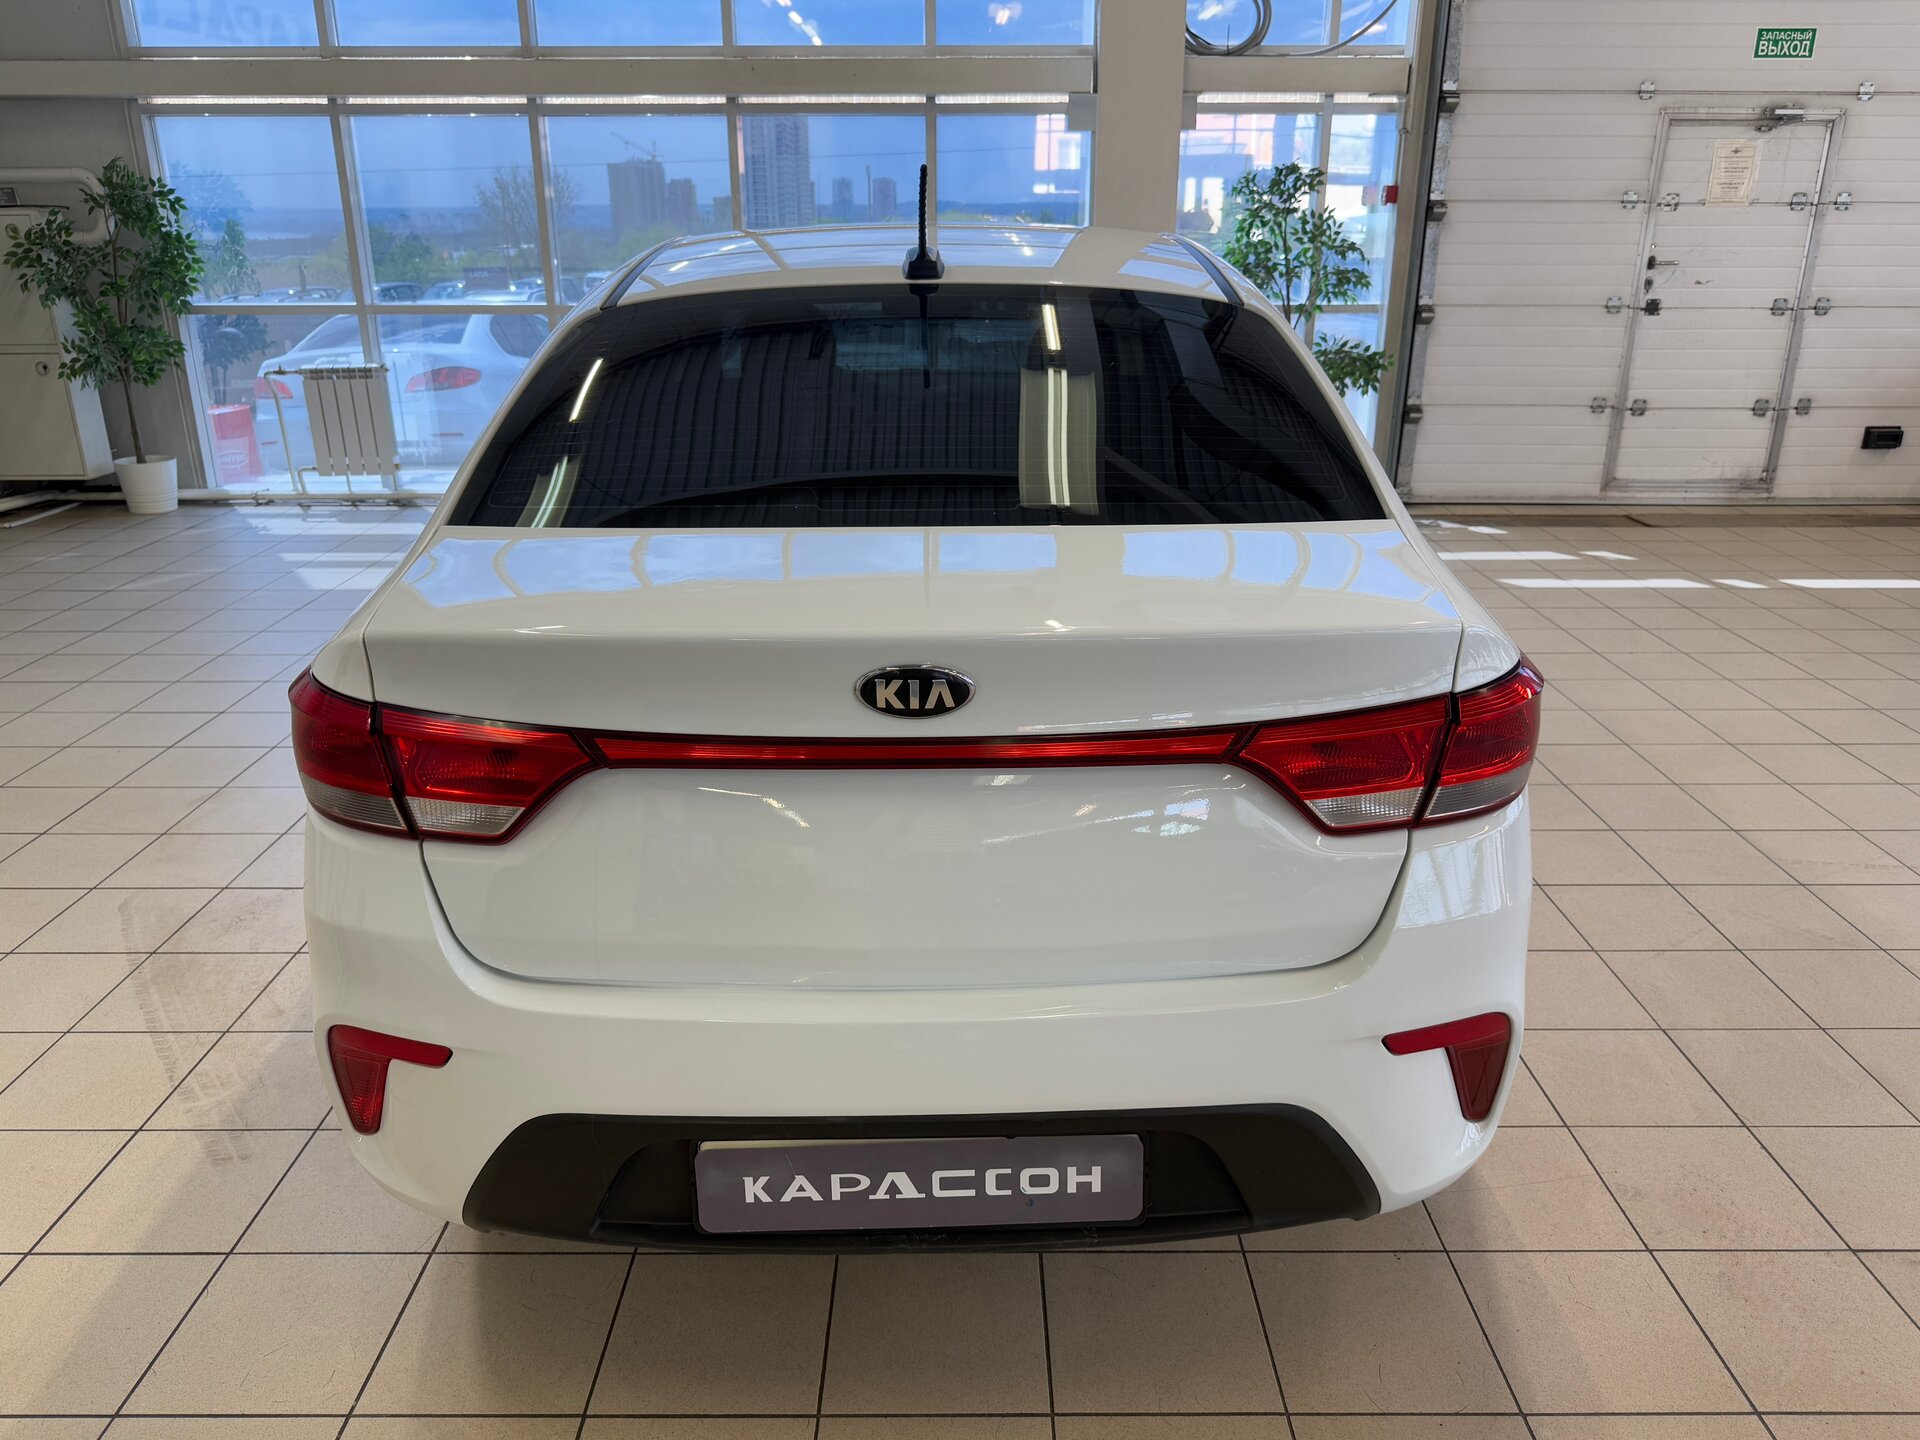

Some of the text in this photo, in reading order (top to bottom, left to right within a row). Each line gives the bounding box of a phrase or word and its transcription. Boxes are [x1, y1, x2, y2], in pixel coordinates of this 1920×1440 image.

[1760, 30, 1813, 40] ЗАПАСНЫЙ
[1758, 41, 1810, 56] ВЫХОД
[875, 679, 956, 709] KIA
